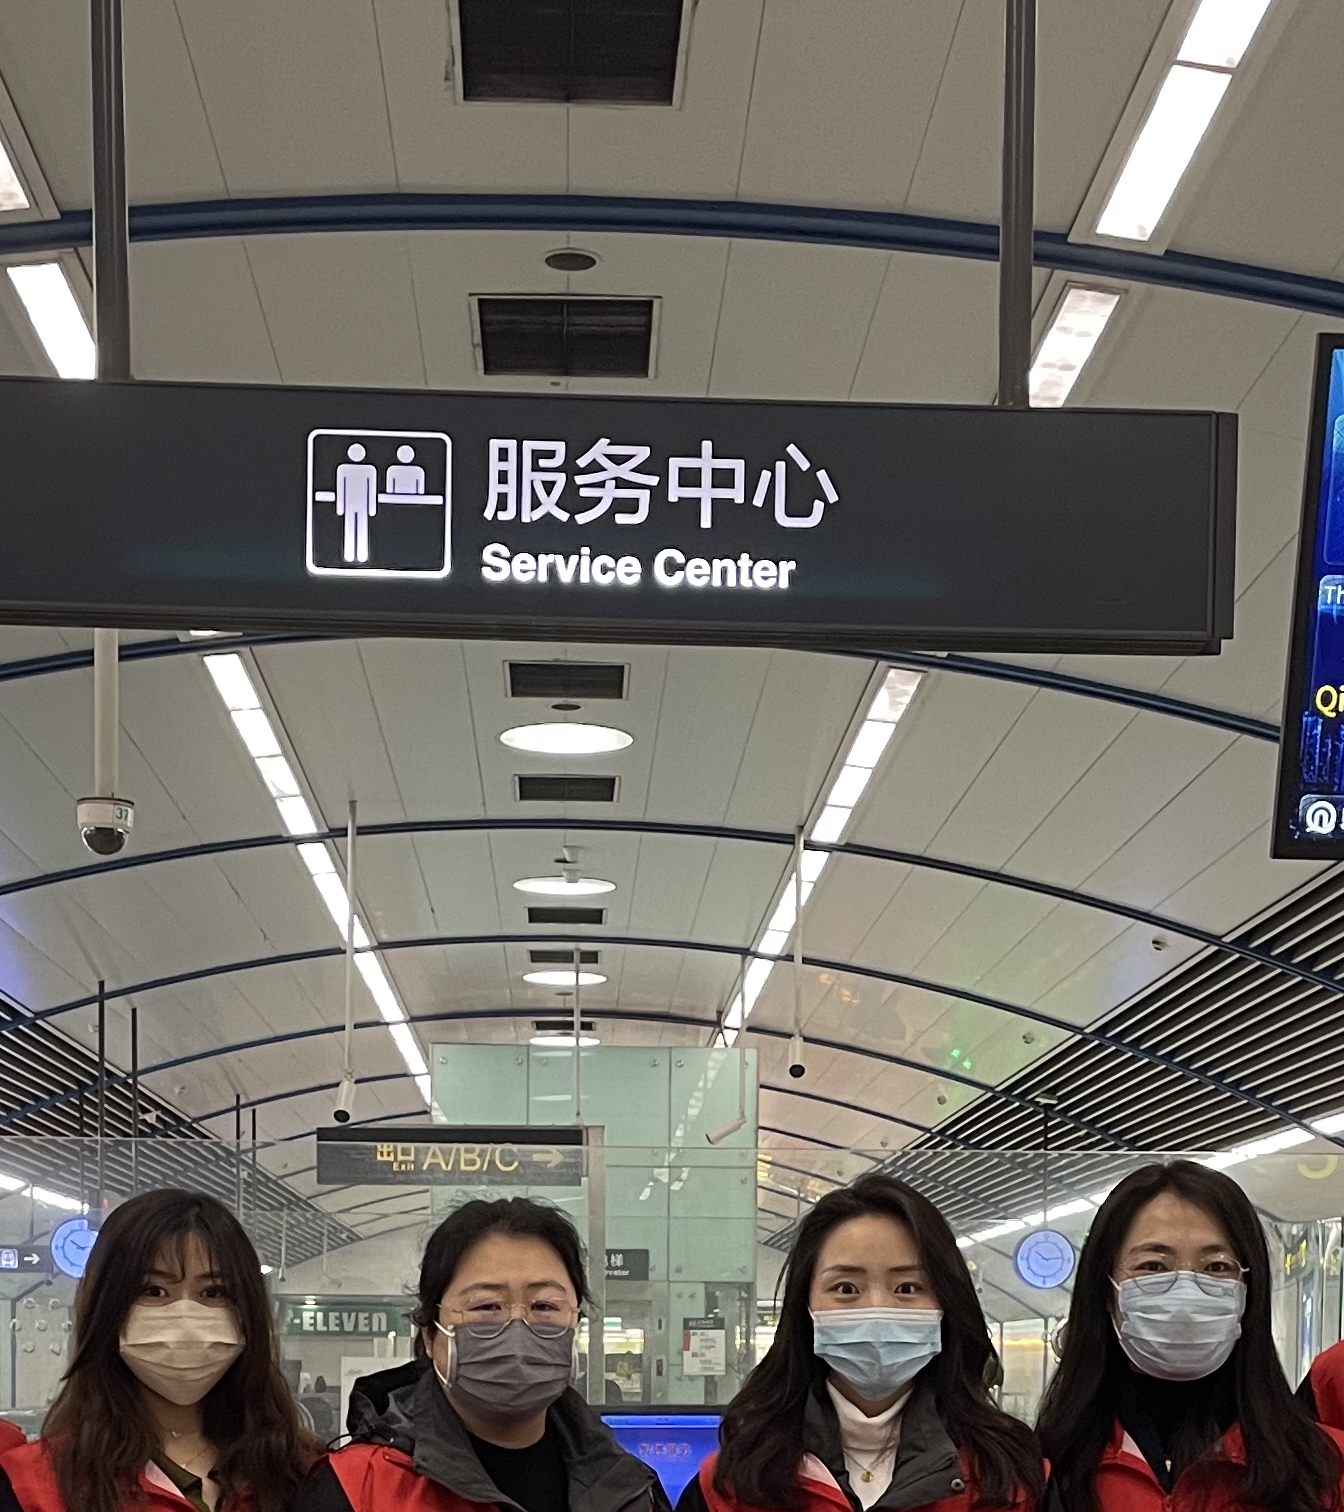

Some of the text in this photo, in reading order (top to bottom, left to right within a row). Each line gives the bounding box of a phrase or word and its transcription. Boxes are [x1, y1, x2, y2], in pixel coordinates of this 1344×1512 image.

[483, 437, 840, 529] 服务中心
[481, 543, 797, 590] Service Center
[376, 1143, 415, 1161] 出口
[392, 1162, 415, 1171] Exit
[423, 1143, 519, 1172] A/B/C
